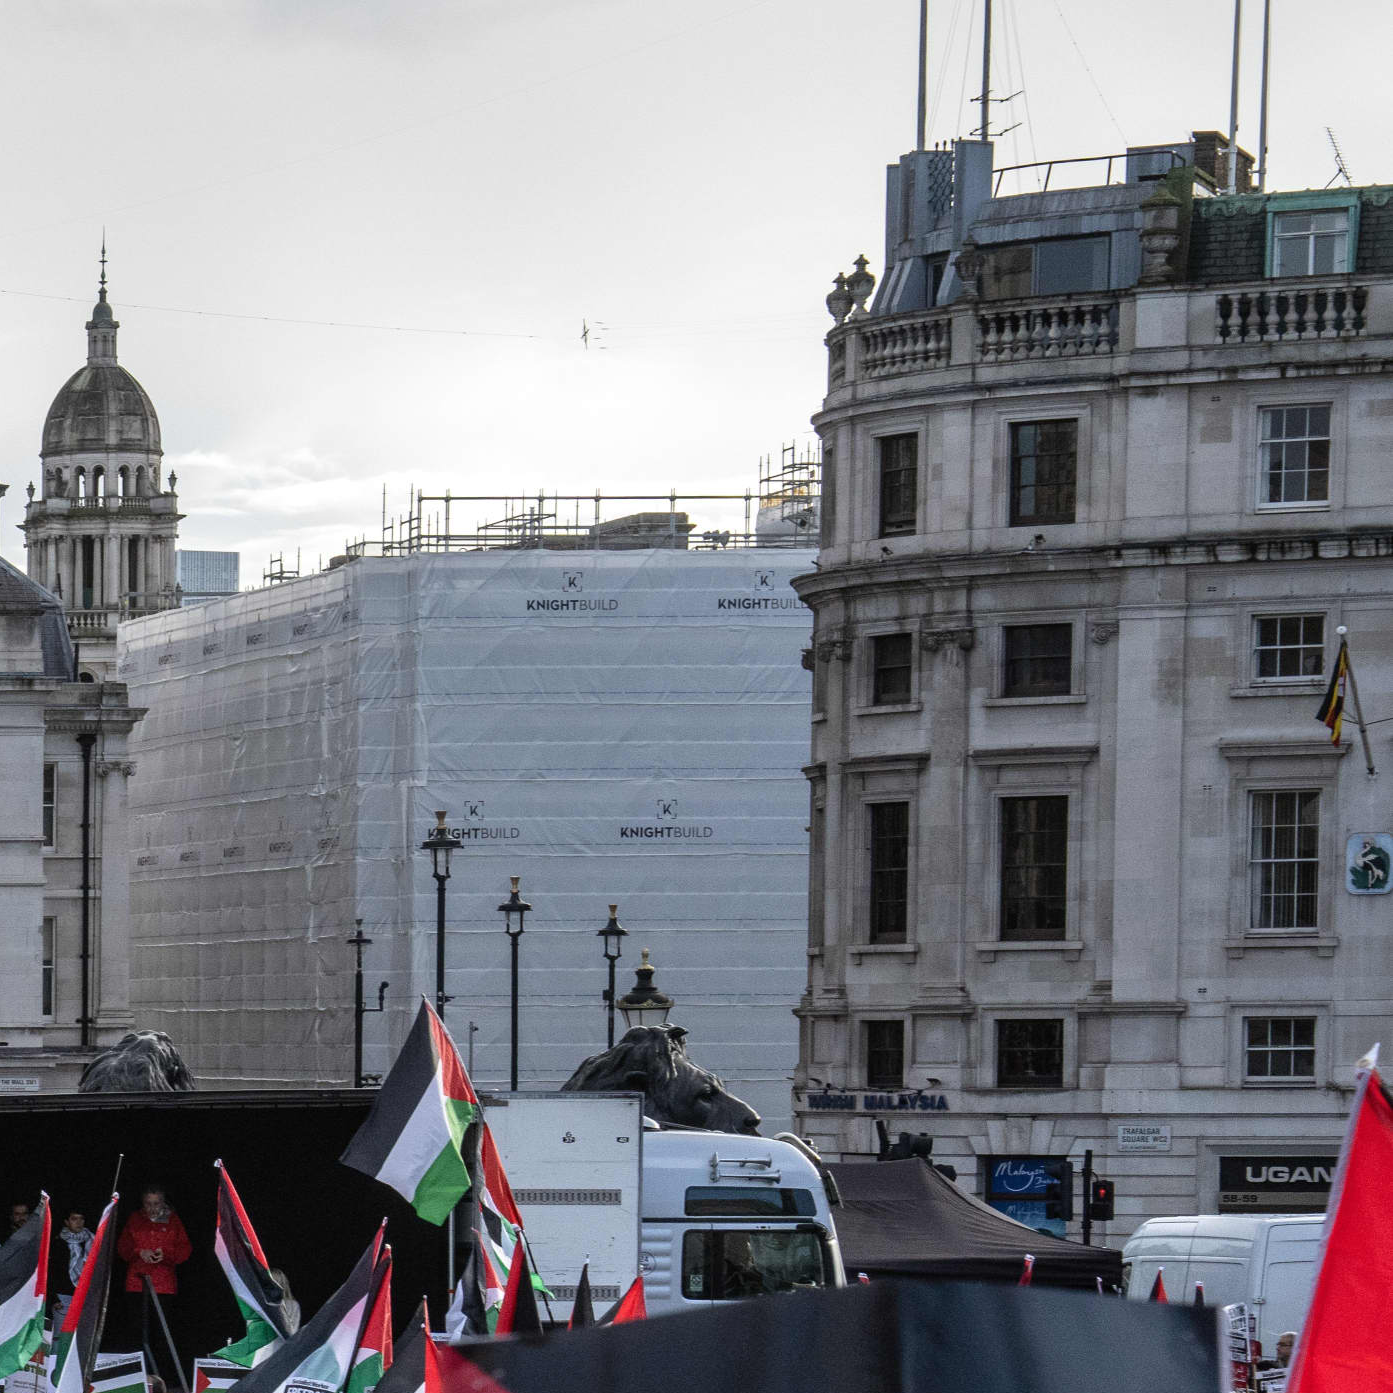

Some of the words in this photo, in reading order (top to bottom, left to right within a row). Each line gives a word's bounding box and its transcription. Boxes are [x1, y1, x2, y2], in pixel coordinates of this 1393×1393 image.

[526, 600, 618, 611] KNIGHTBUILD
[620, 827, 713, 838] KNIGHTBUILD
[1122, 1128, 1161, 1136] TRAFALGAR
[1122, 1136, 1150, 1144] SQUARE
[1245, 1166, 1333, 1183] UGAN
